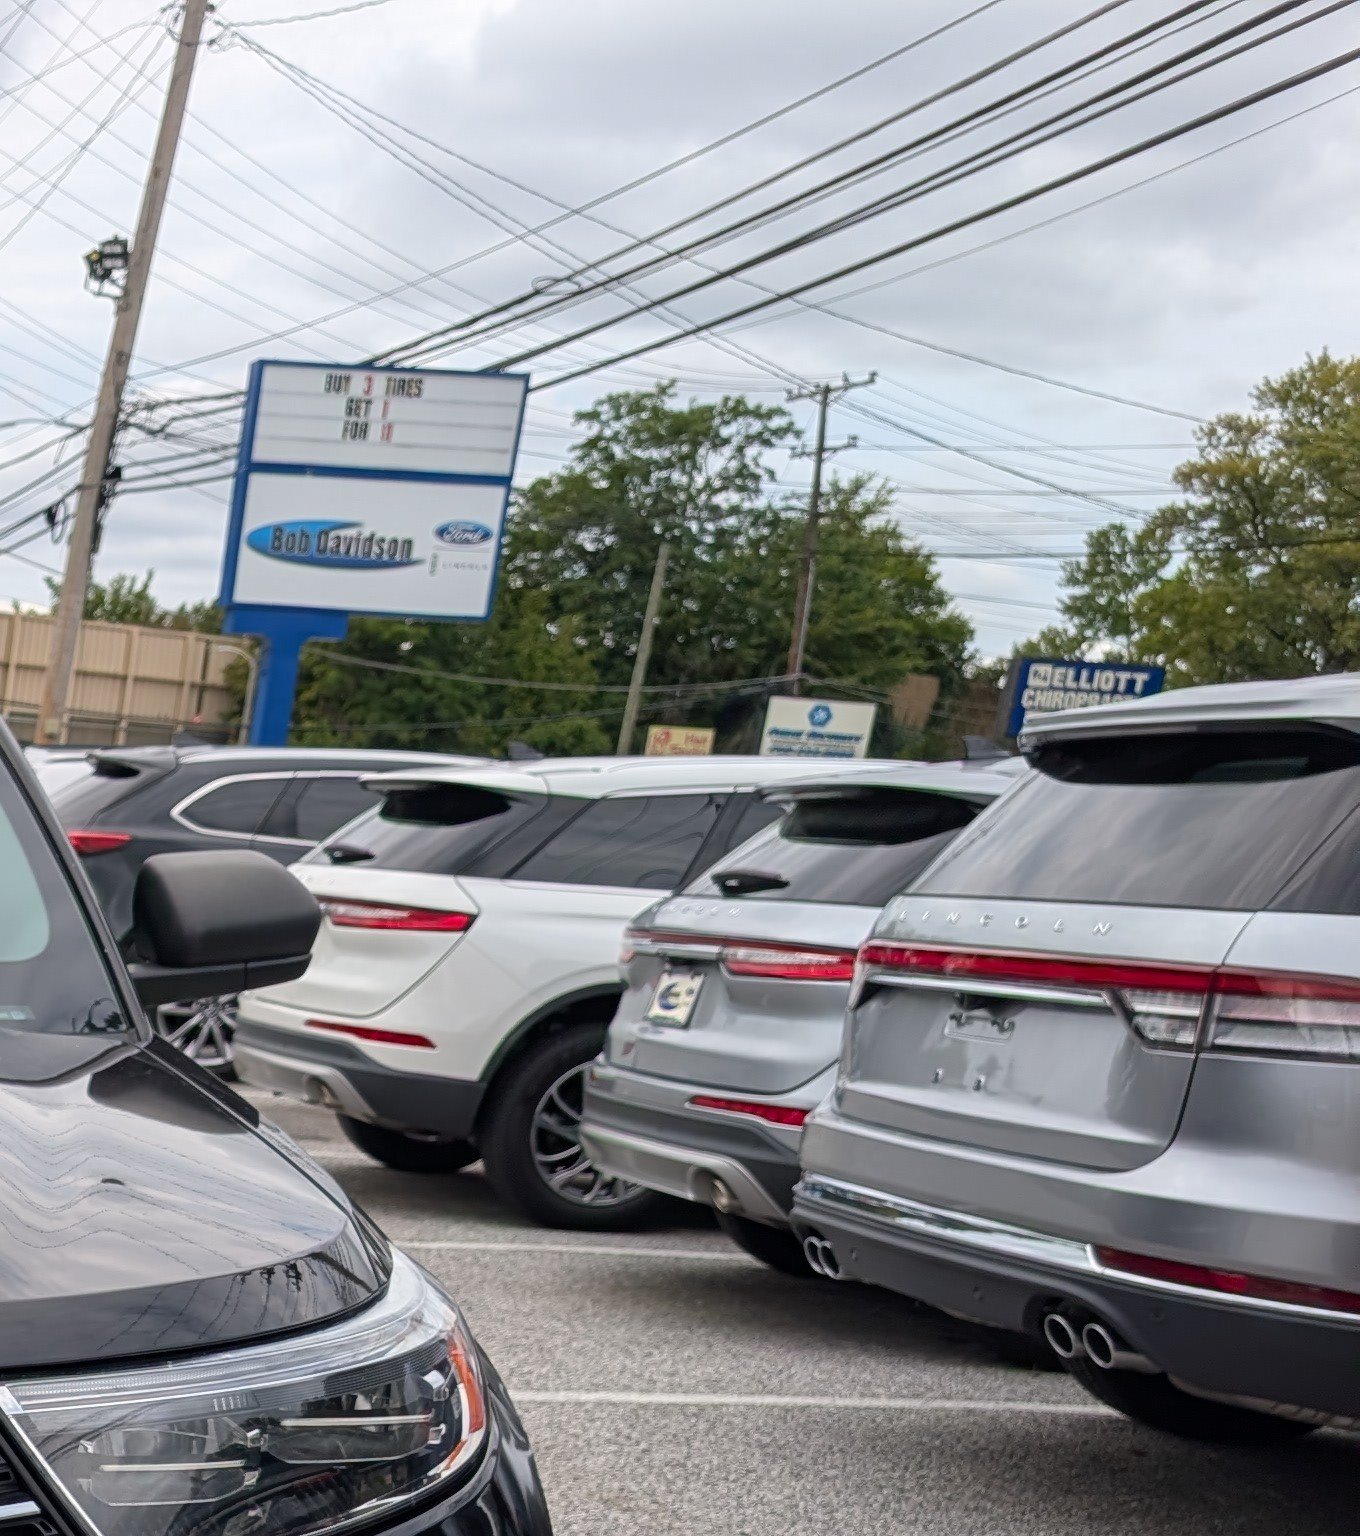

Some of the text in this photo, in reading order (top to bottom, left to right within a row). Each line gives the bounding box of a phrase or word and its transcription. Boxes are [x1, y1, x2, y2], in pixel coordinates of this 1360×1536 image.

[324, 373, 351, 395] BUY
[385, 376, 424, 399] TIRES
[345, 397, 372, 418] GET
[342, 420, 369, 440] FOR
[271, 526, 414, 562] Bob Davidson
[1051, 666, 1150, 694] ELLIOTT
[1020, 687, 1140, 711] CHIROPR
[897, 910, 1112, 936] LINCOLN
